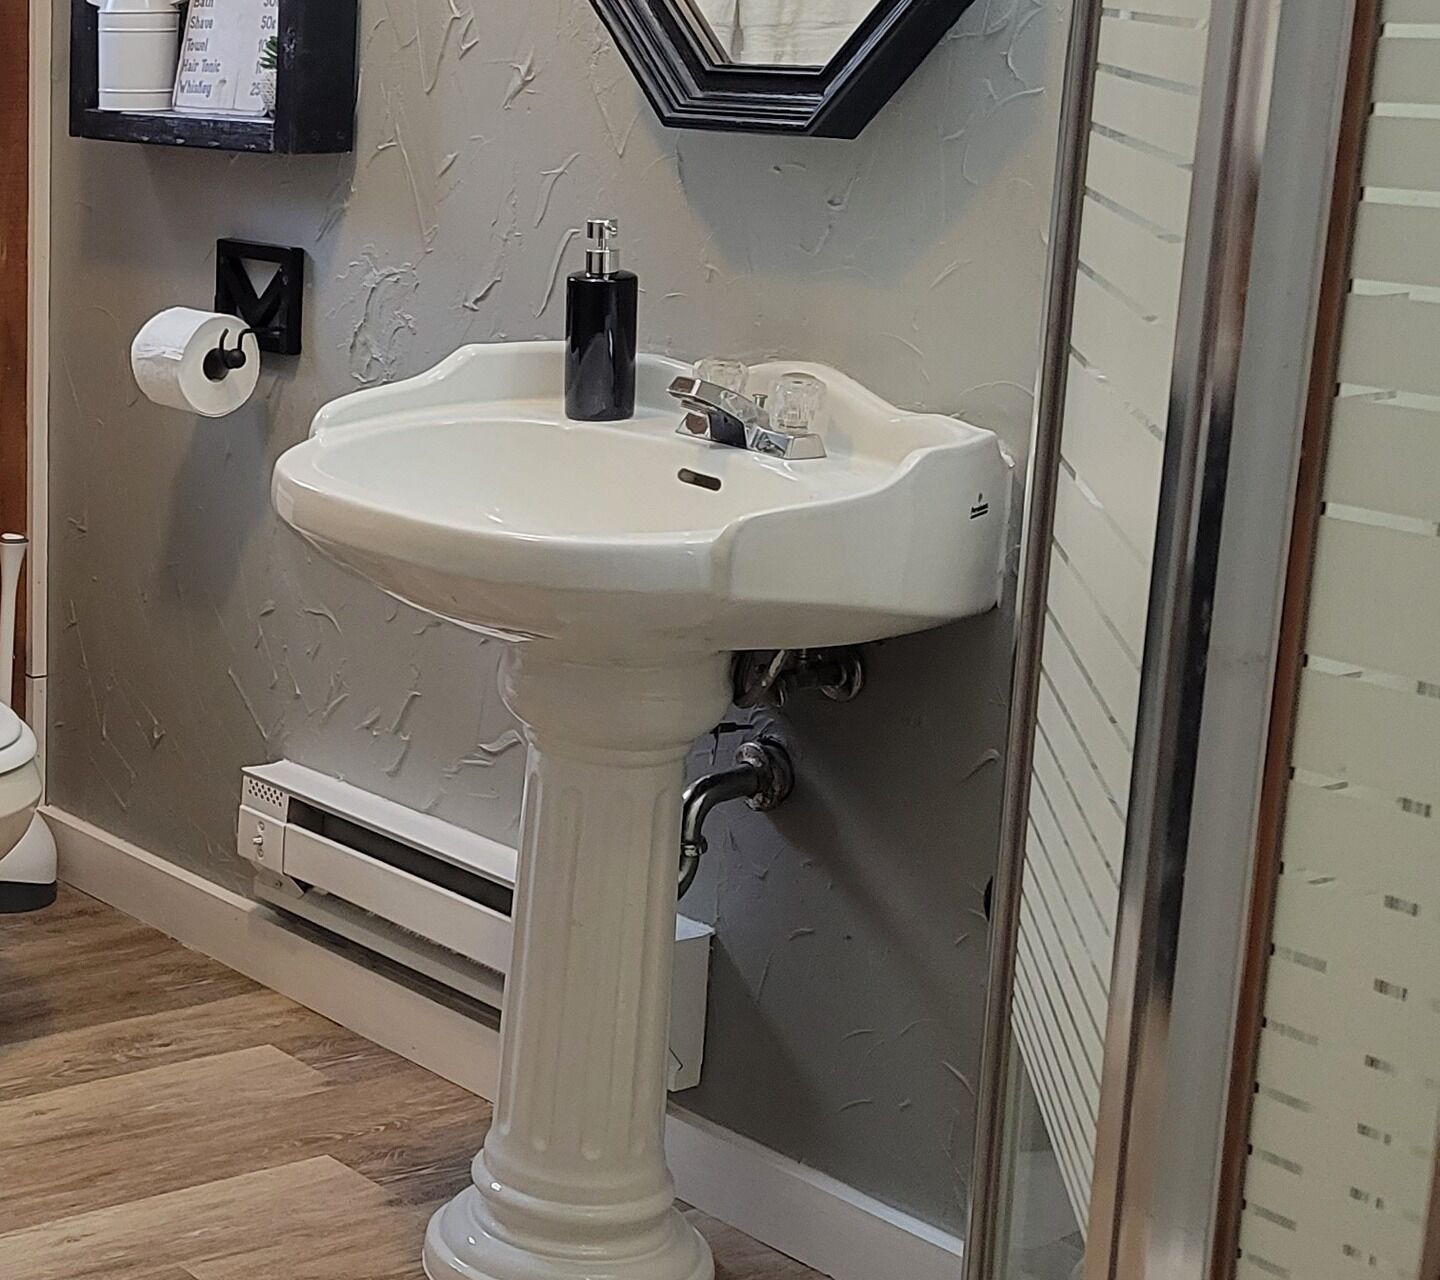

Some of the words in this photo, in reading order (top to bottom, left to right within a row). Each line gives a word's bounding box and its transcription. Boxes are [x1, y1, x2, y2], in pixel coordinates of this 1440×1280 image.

[189, 15, 214, 30] Shave
[186, 37, 209, 52] Towel
[182, 59, 199, 73] Hair
[201, 58, 221, 73] Tonic
